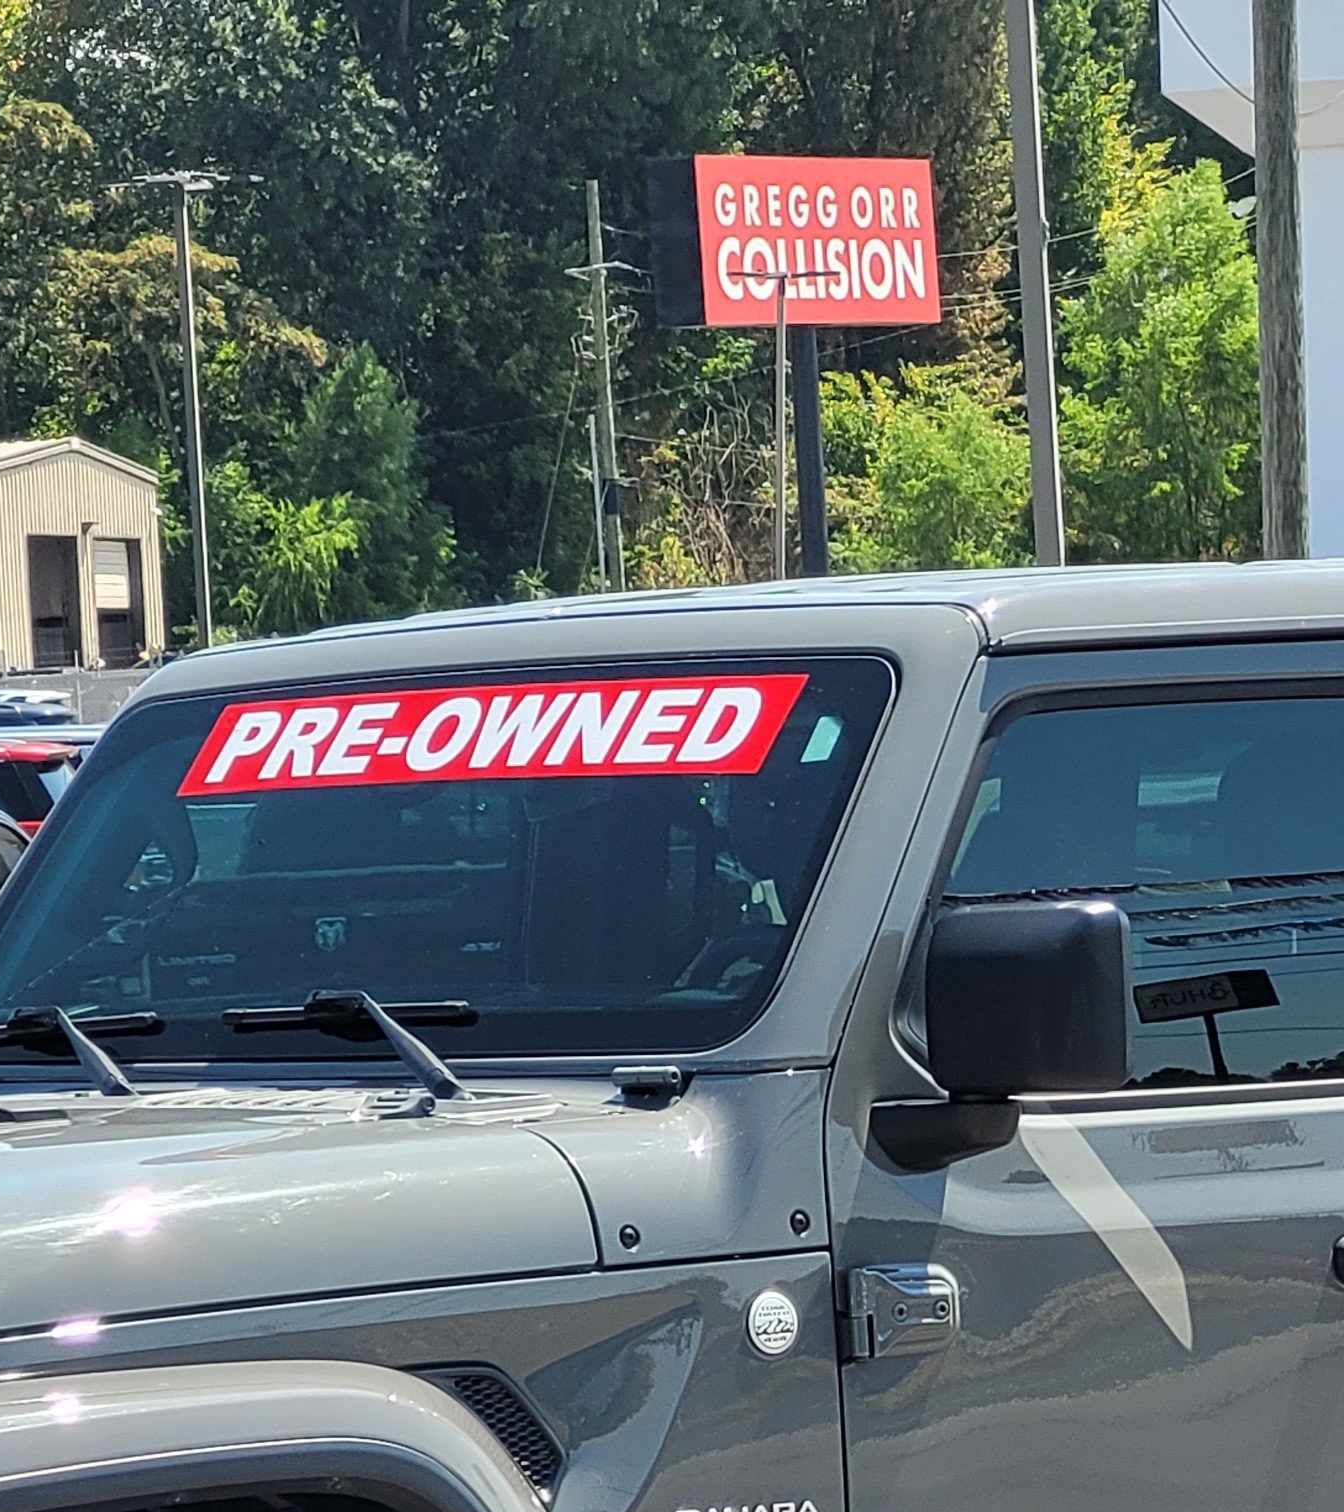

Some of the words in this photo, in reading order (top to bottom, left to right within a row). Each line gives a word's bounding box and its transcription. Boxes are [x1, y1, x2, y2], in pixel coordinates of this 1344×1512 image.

[714, 182, 838, 228] GREGG
[850, 186, 921, 229] ORR
[717, 236, 926, 300] COLLISION
[204, 686, 762, 783] PRE-OWNED
